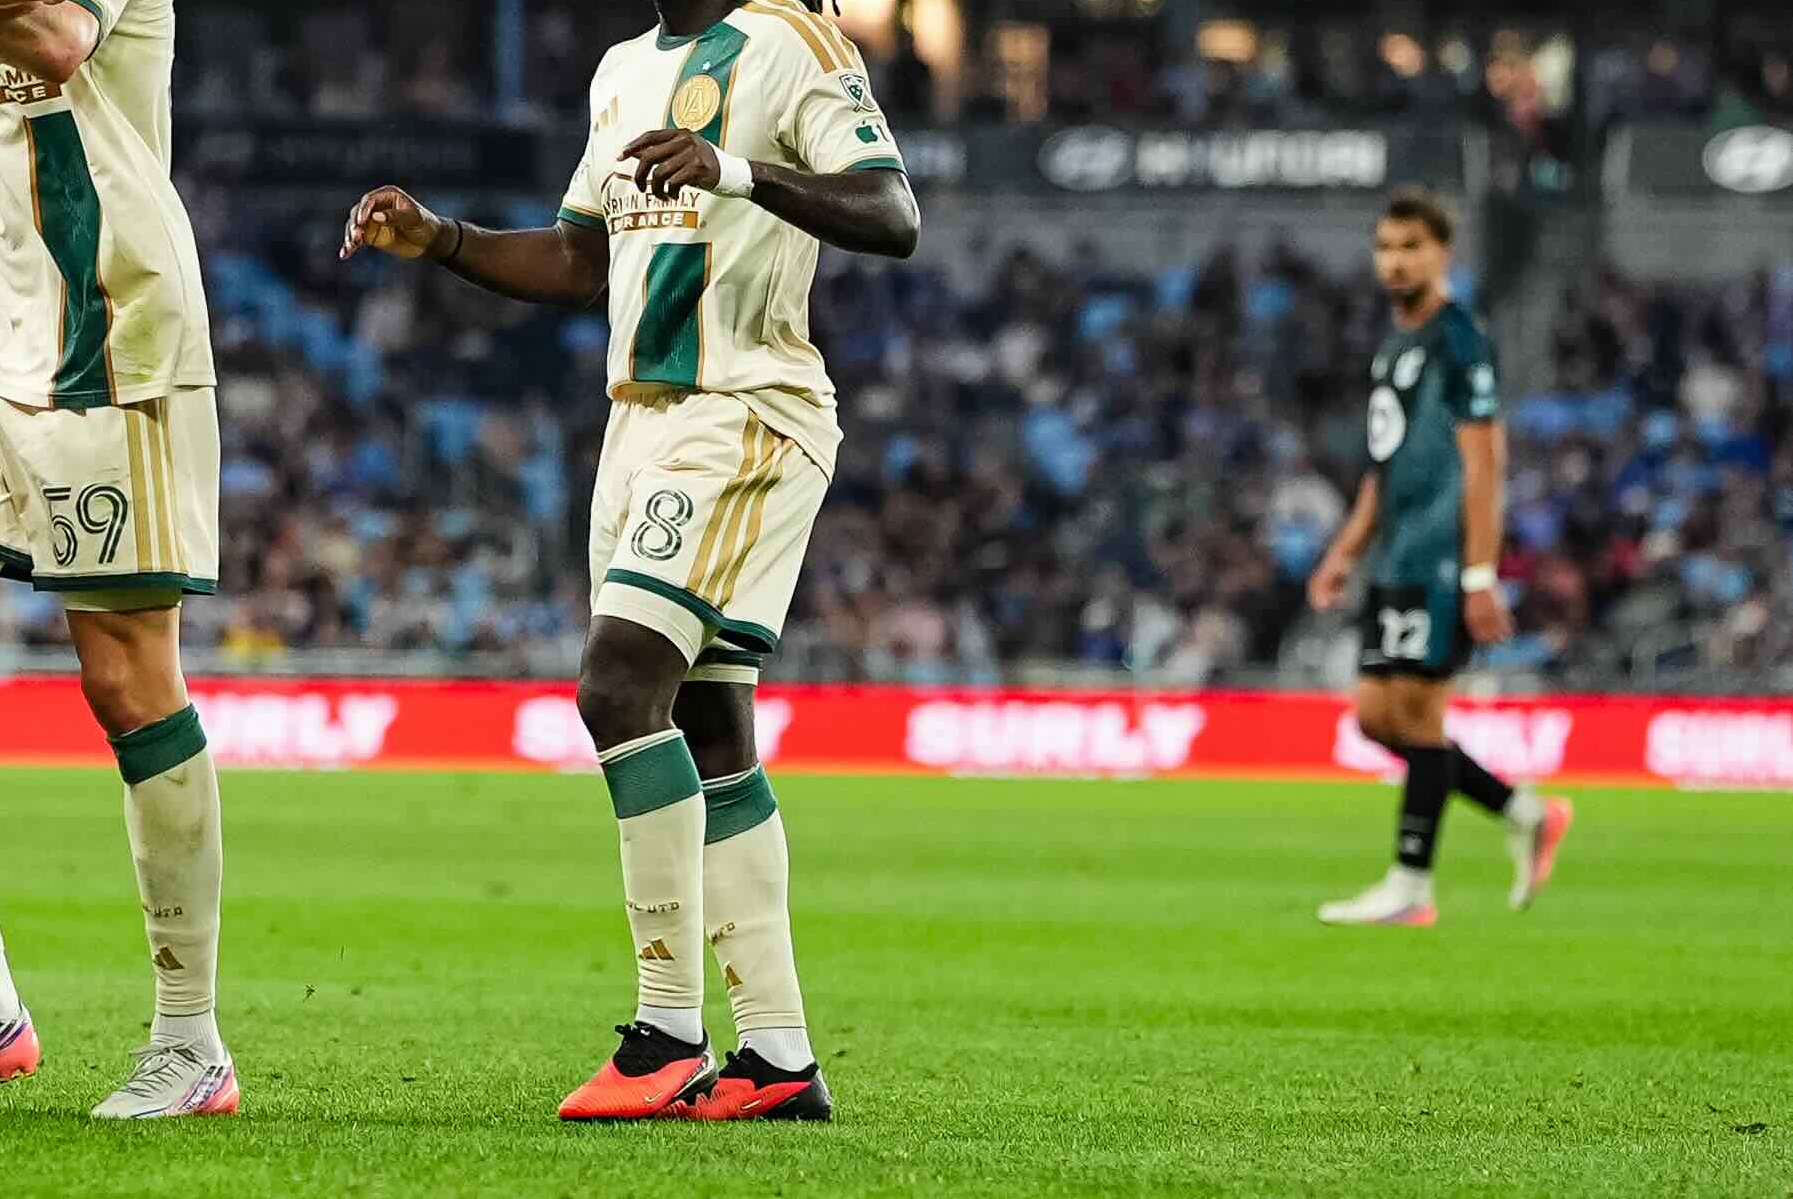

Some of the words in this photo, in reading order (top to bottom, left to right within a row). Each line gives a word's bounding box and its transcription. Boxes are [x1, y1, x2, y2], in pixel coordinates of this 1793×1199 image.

[43, 483, 128, 567] 59
[631, 489, 694, 561] 8
[904, 699, 1206, 770] SURLY
